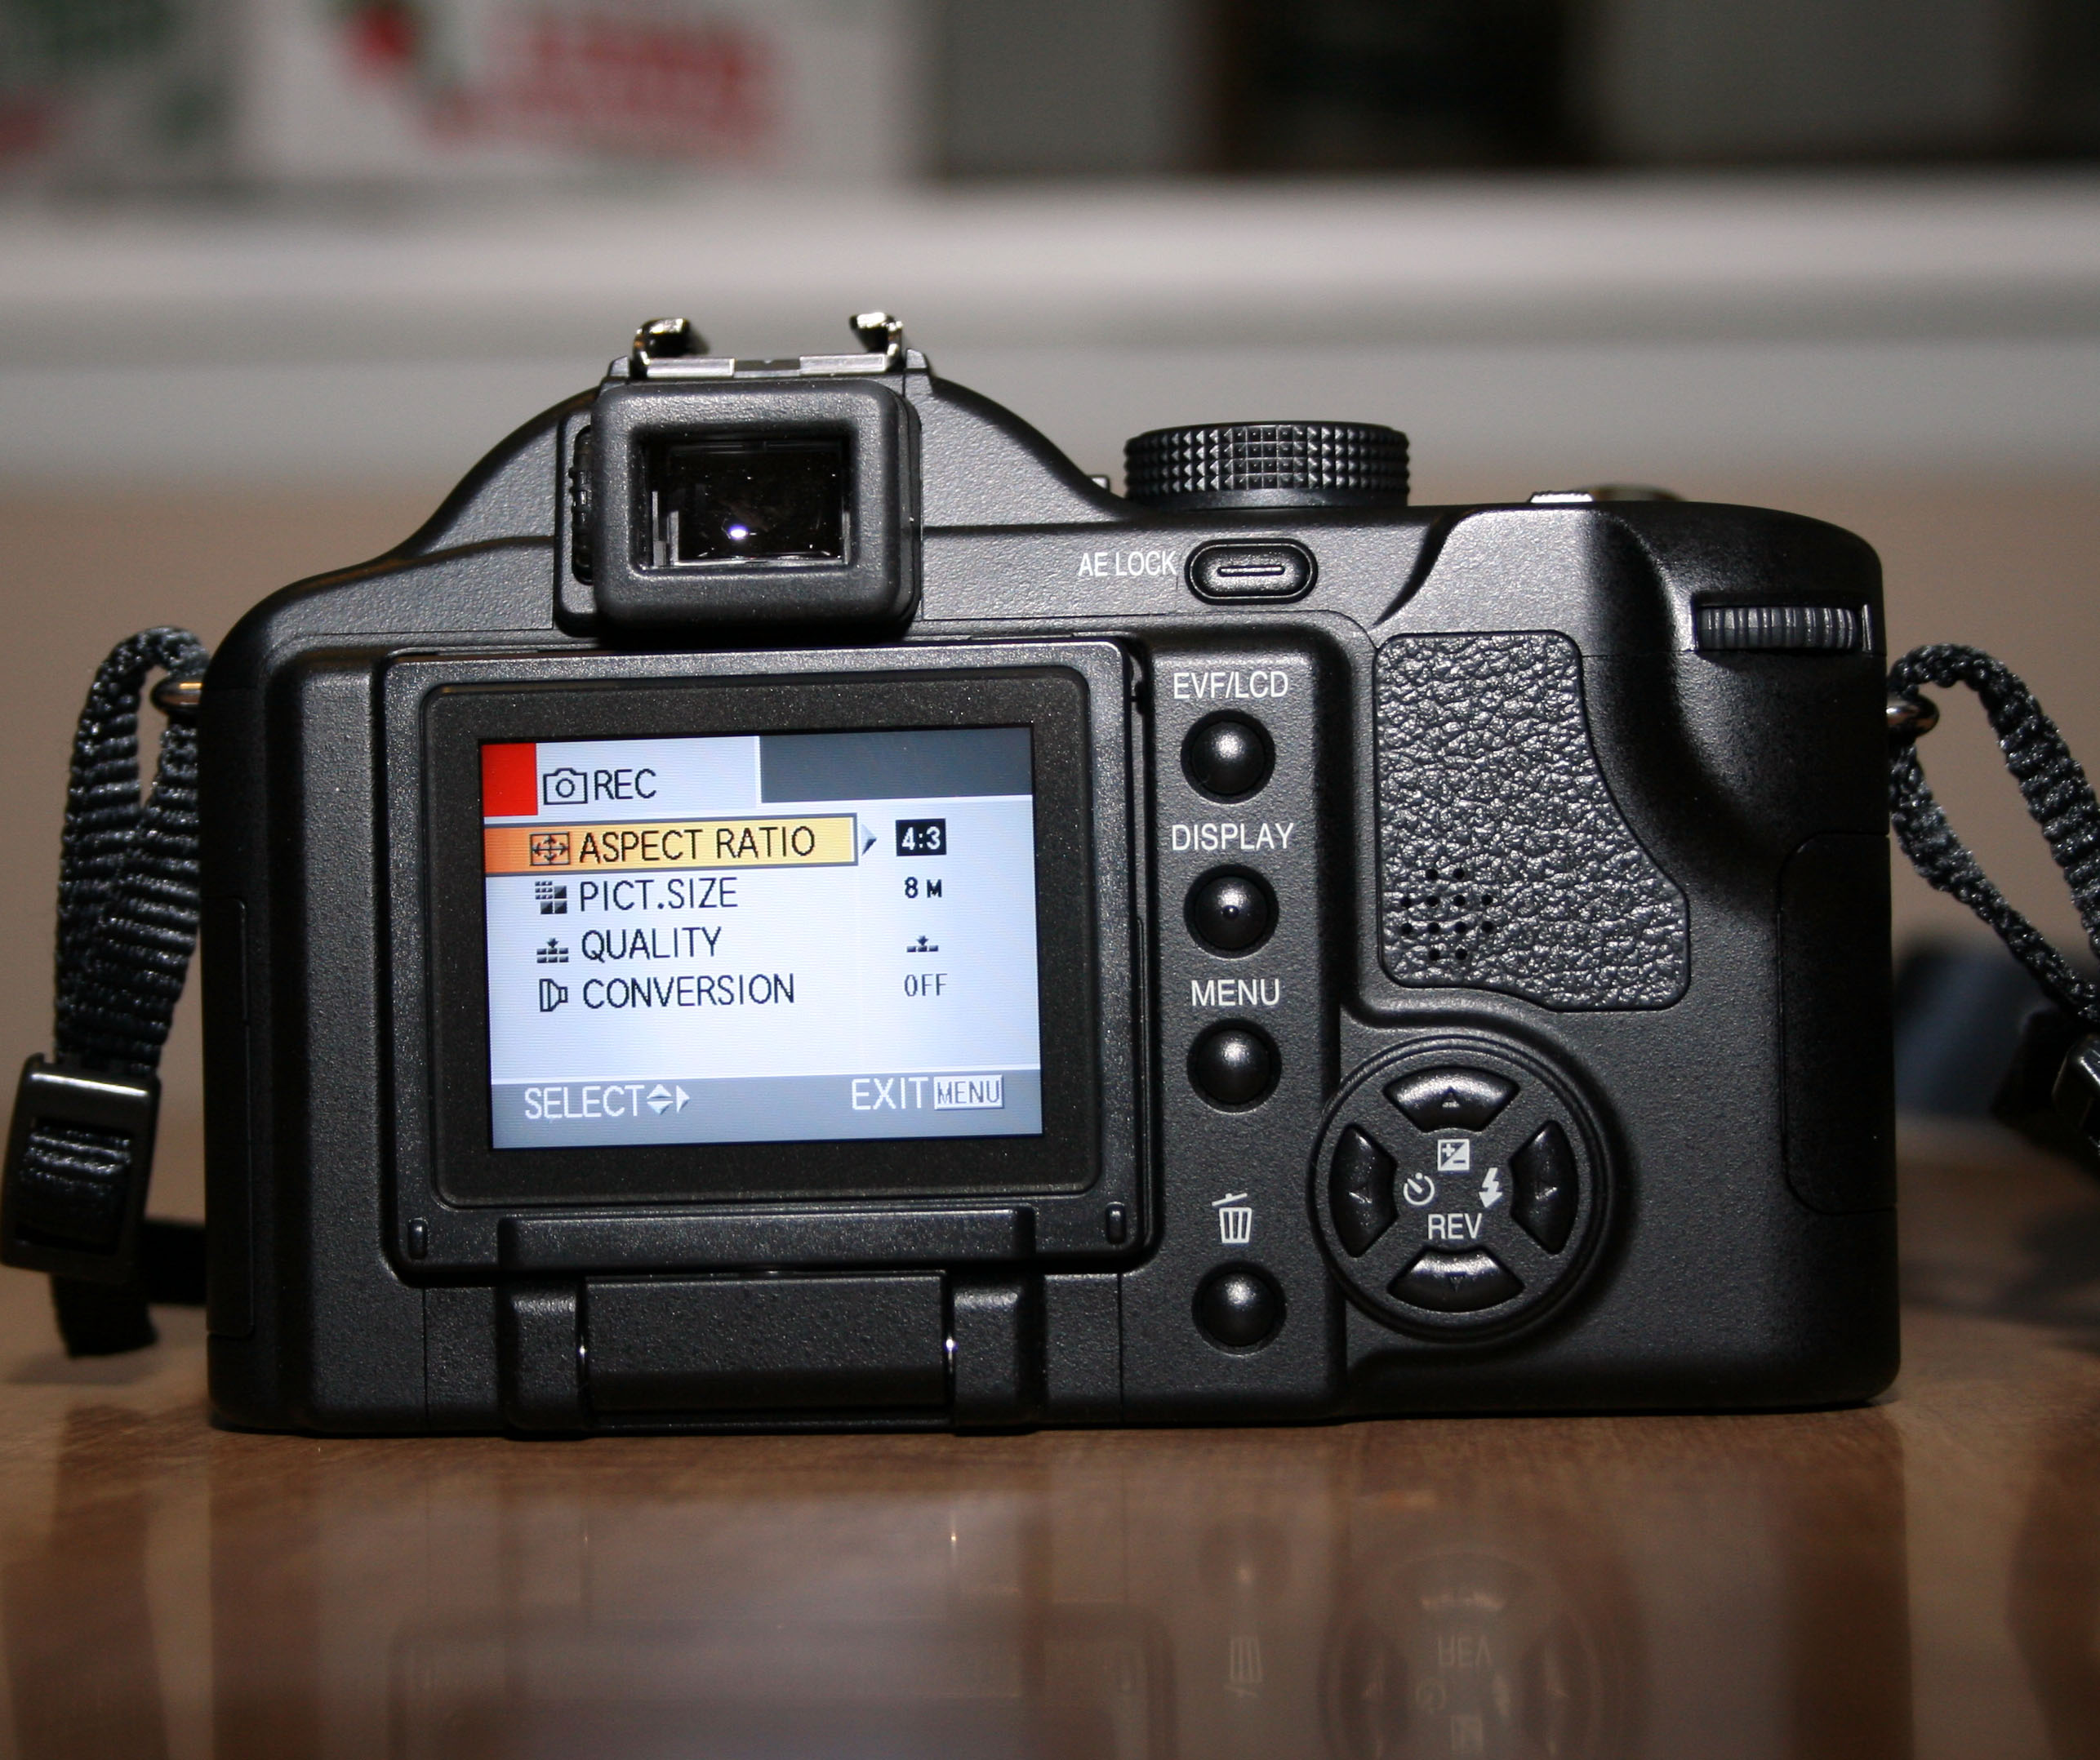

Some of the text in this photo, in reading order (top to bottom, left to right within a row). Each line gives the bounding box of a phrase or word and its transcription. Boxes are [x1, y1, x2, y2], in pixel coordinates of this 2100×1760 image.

[1079, 551, 1177, 576] AE LOCK
[1172, 671, 1289, 700] EVF/LCD
[594, 769, 657, 801] REC
[578, 826, 816, 864] ASPECT RATIO
[900, 824, 941, 851] 4:3
[1171, 822, 1294, 851] DISPLAY
[579, 877, 738, 913] PICT.SIZE
[581, 927, 722, 963] QUALITY
[582, 973, 795, 1010] CONVERSION
[904, 973, 948, 998] OFF
[1190, 980, 1280, 1007] MENU
[524, 1084, 644, 1121] SELECT
[852, 1077, 1001, 1110] EXIT MENU
[1427, 1214, 1483, 1240] REV
